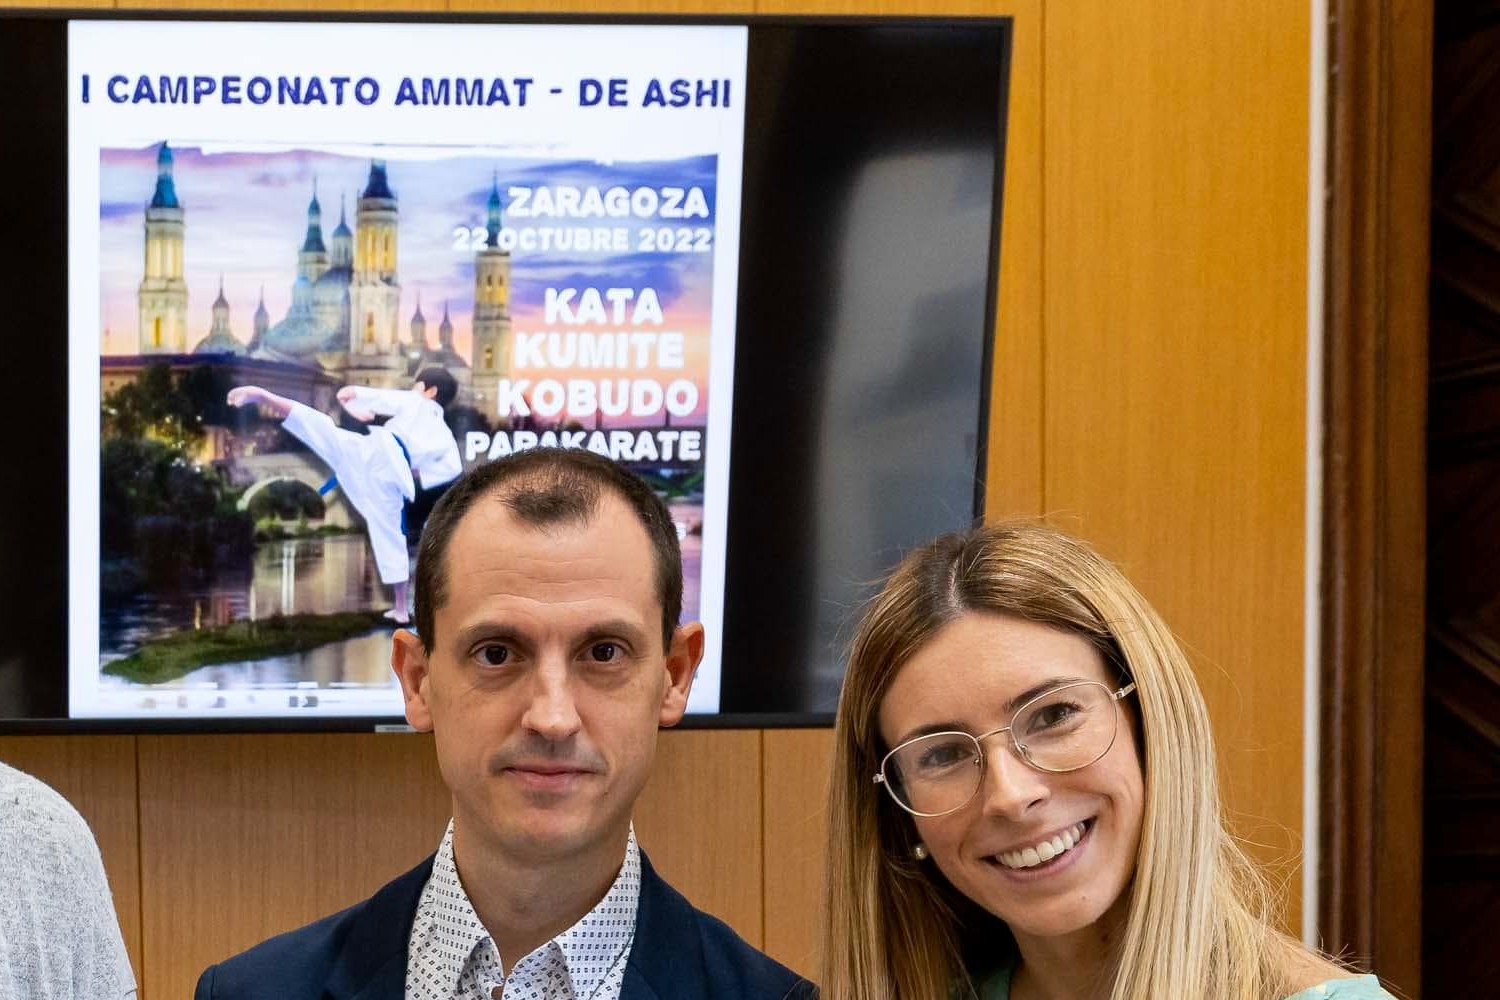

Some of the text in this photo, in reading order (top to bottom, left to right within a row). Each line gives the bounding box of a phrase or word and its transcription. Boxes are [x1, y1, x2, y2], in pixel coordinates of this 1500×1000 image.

[81, 74, 90, 104] I
[107, 75, 380, 106] CAMPEONATO
[394, 77, 533, 107] AMMAT
[579, 79, 628, 107] DE
[642, 78, 731, 108] ASHI
[507, 186, 710, 219] ZARAGOZA
[453, 227, 712, 253] 22 OCTUBRE 2022
[544, 287, 664, 325] KATA
[514, 331, 684, 369] KUMITE
[497, 379, 699, 418] KOBUDO
